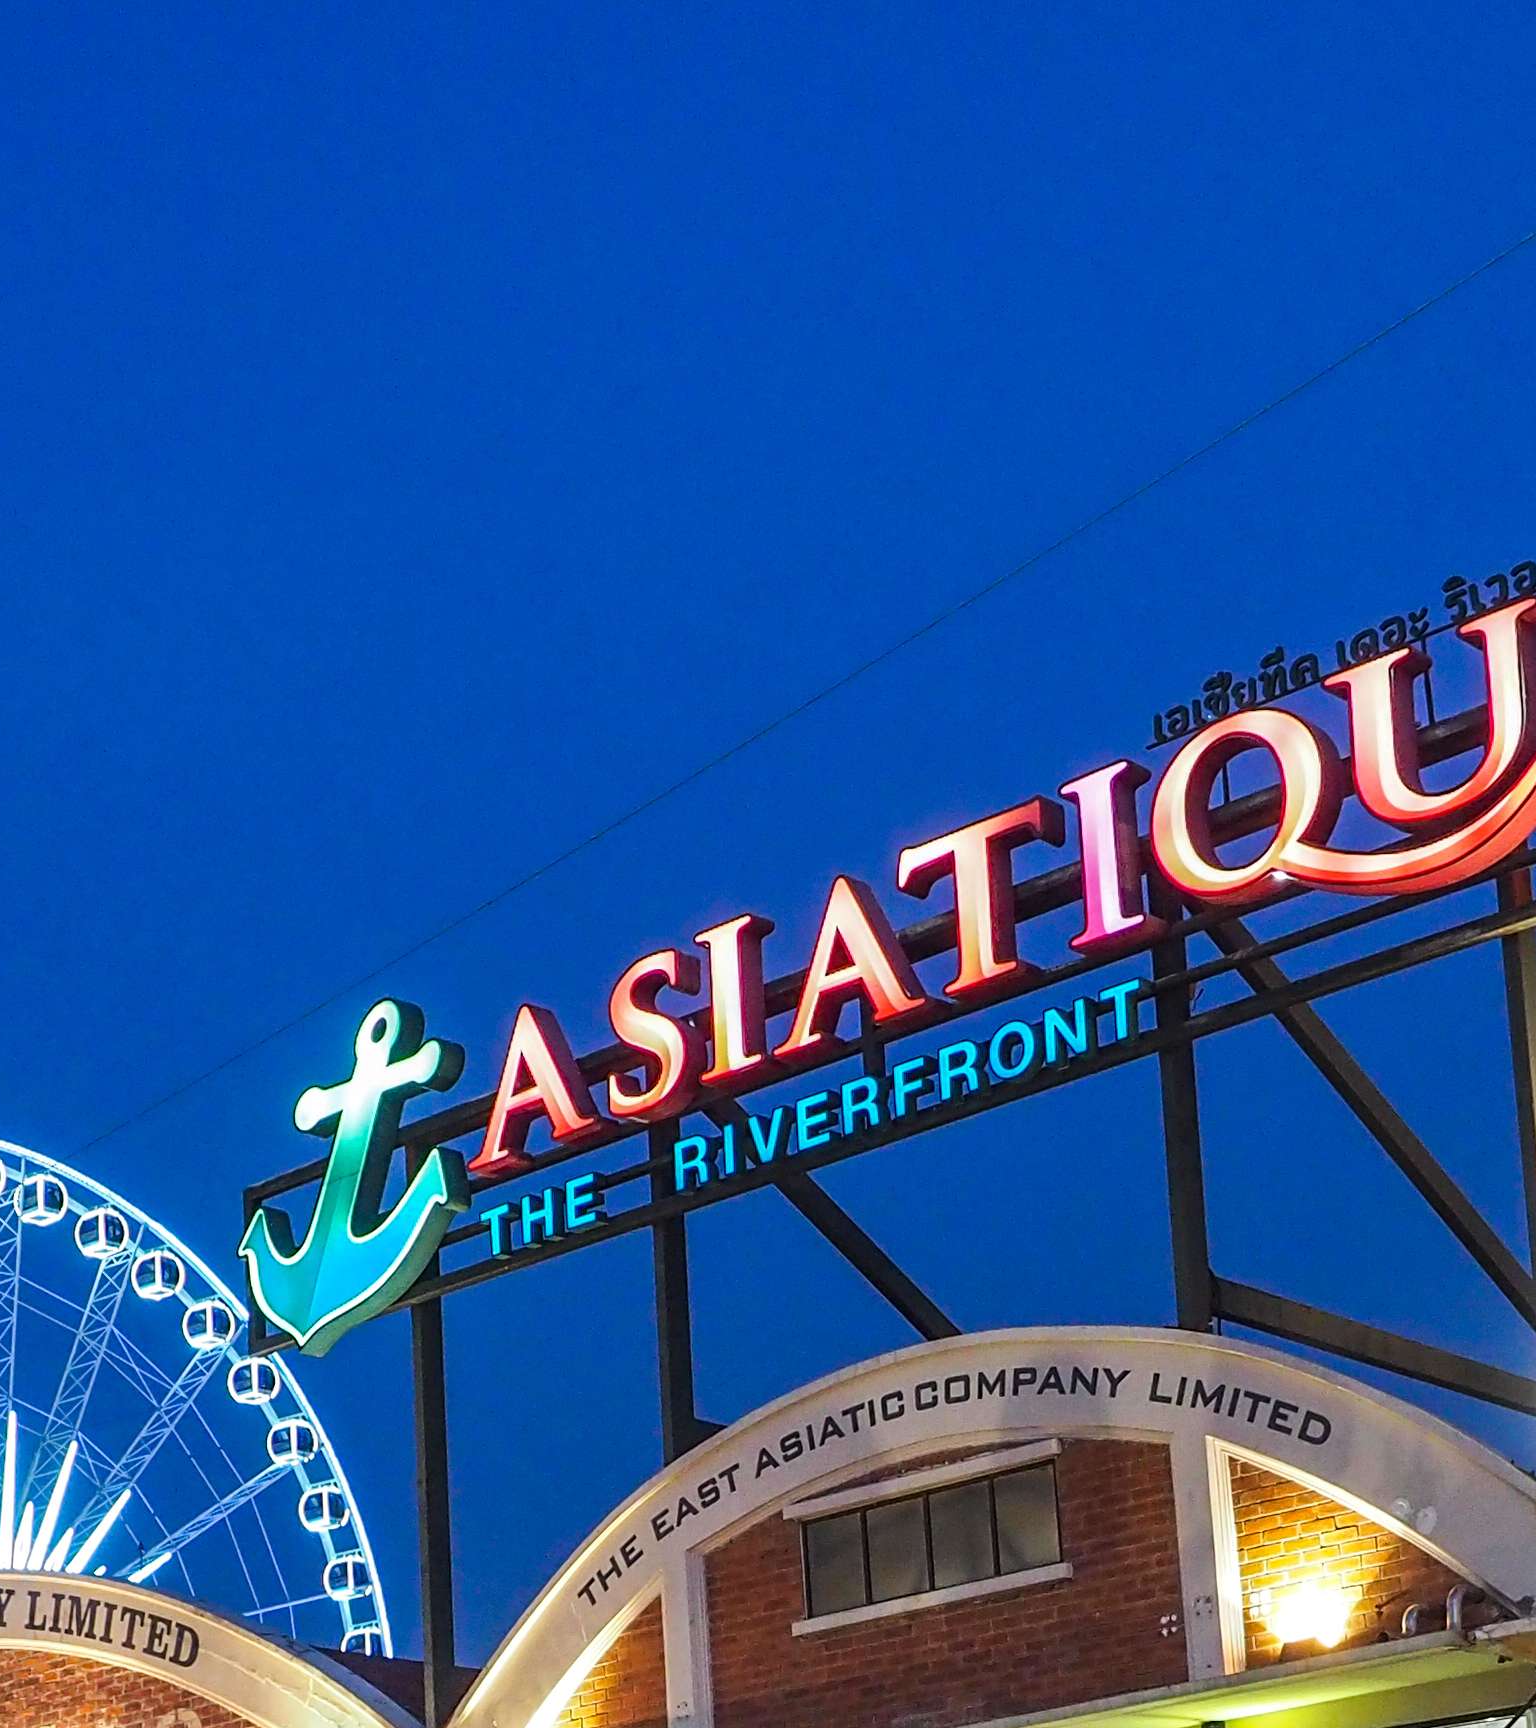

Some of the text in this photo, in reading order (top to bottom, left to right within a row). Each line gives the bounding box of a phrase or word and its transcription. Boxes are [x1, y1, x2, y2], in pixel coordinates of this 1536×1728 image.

[479, 975, 1156, 1260] THE RIVERFRONT
[576, 1365, 1334, 1609] THE EAST ASIATIC COMPANY LIMITED
[24, 1589, 202, 1669] LIMITED
